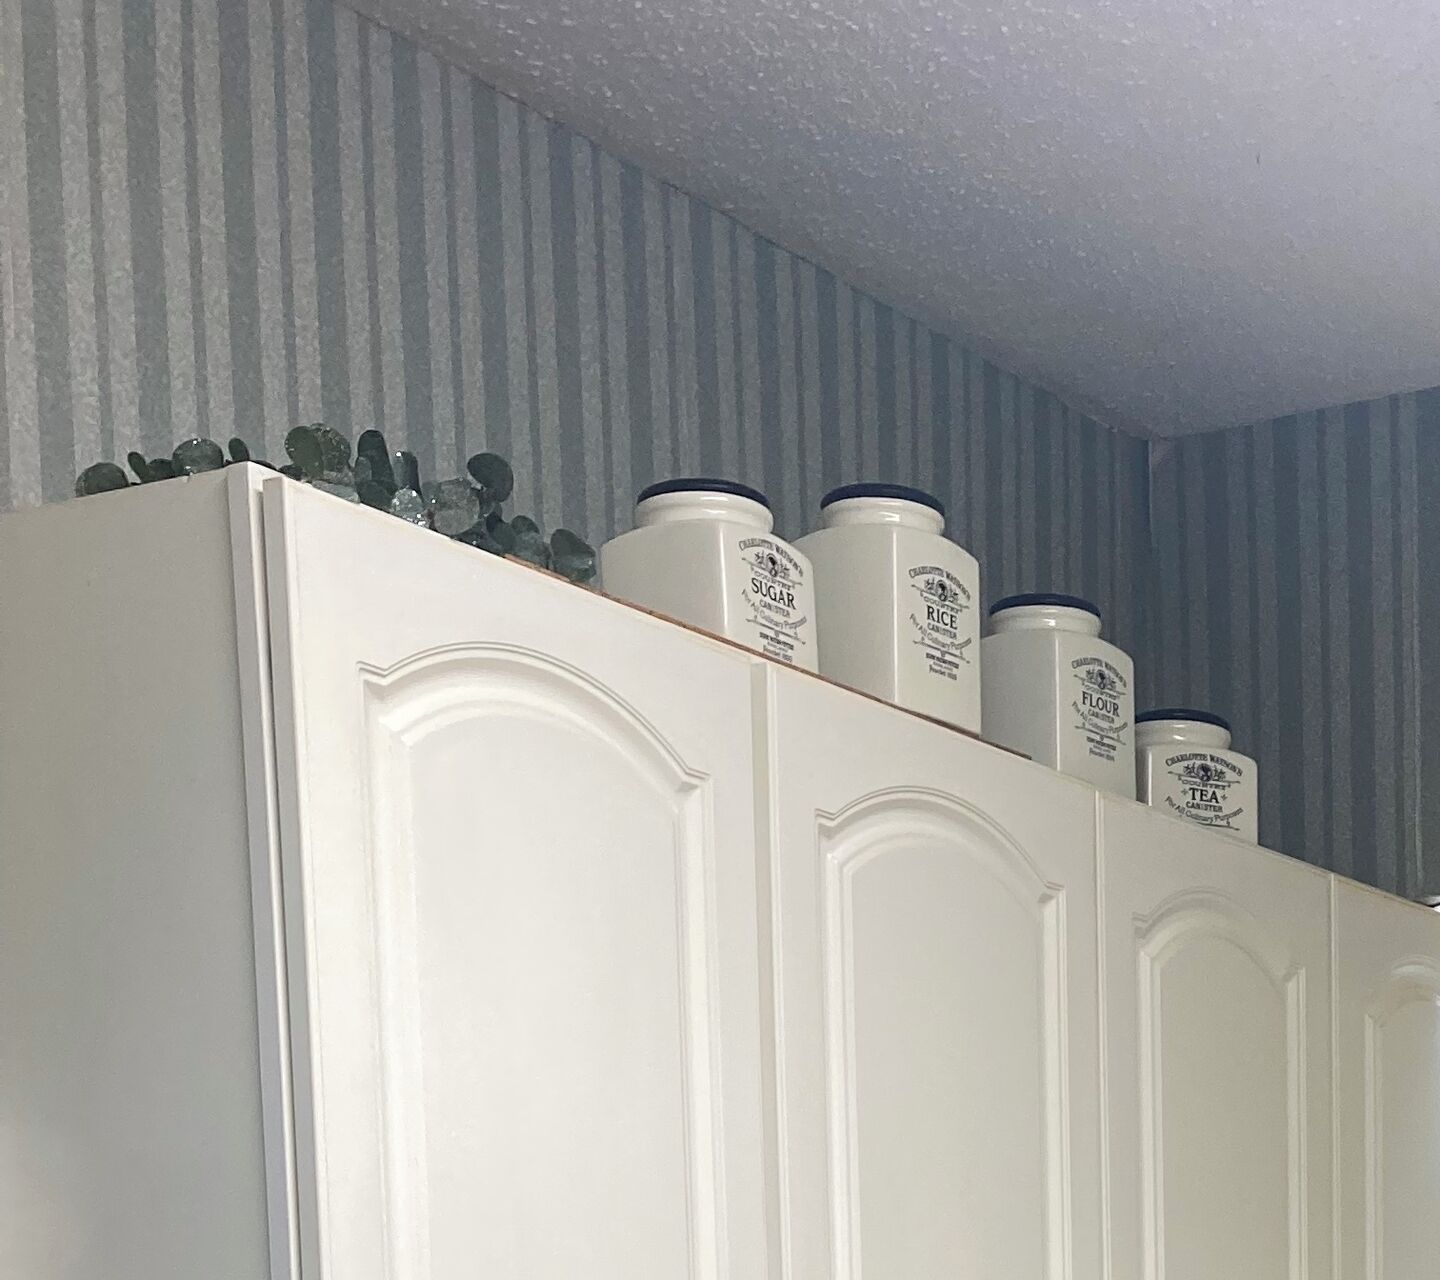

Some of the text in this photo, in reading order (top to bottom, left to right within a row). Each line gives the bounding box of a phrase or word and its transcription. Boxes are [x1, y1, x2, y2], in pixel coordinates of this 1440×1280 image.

[751, 577, 797, 610] SUGAR
[926, 604, 958, 630] RICE
[1081, 690, 1120, 717] FLOUR
[1188, 787, 1220, 804] TEA
